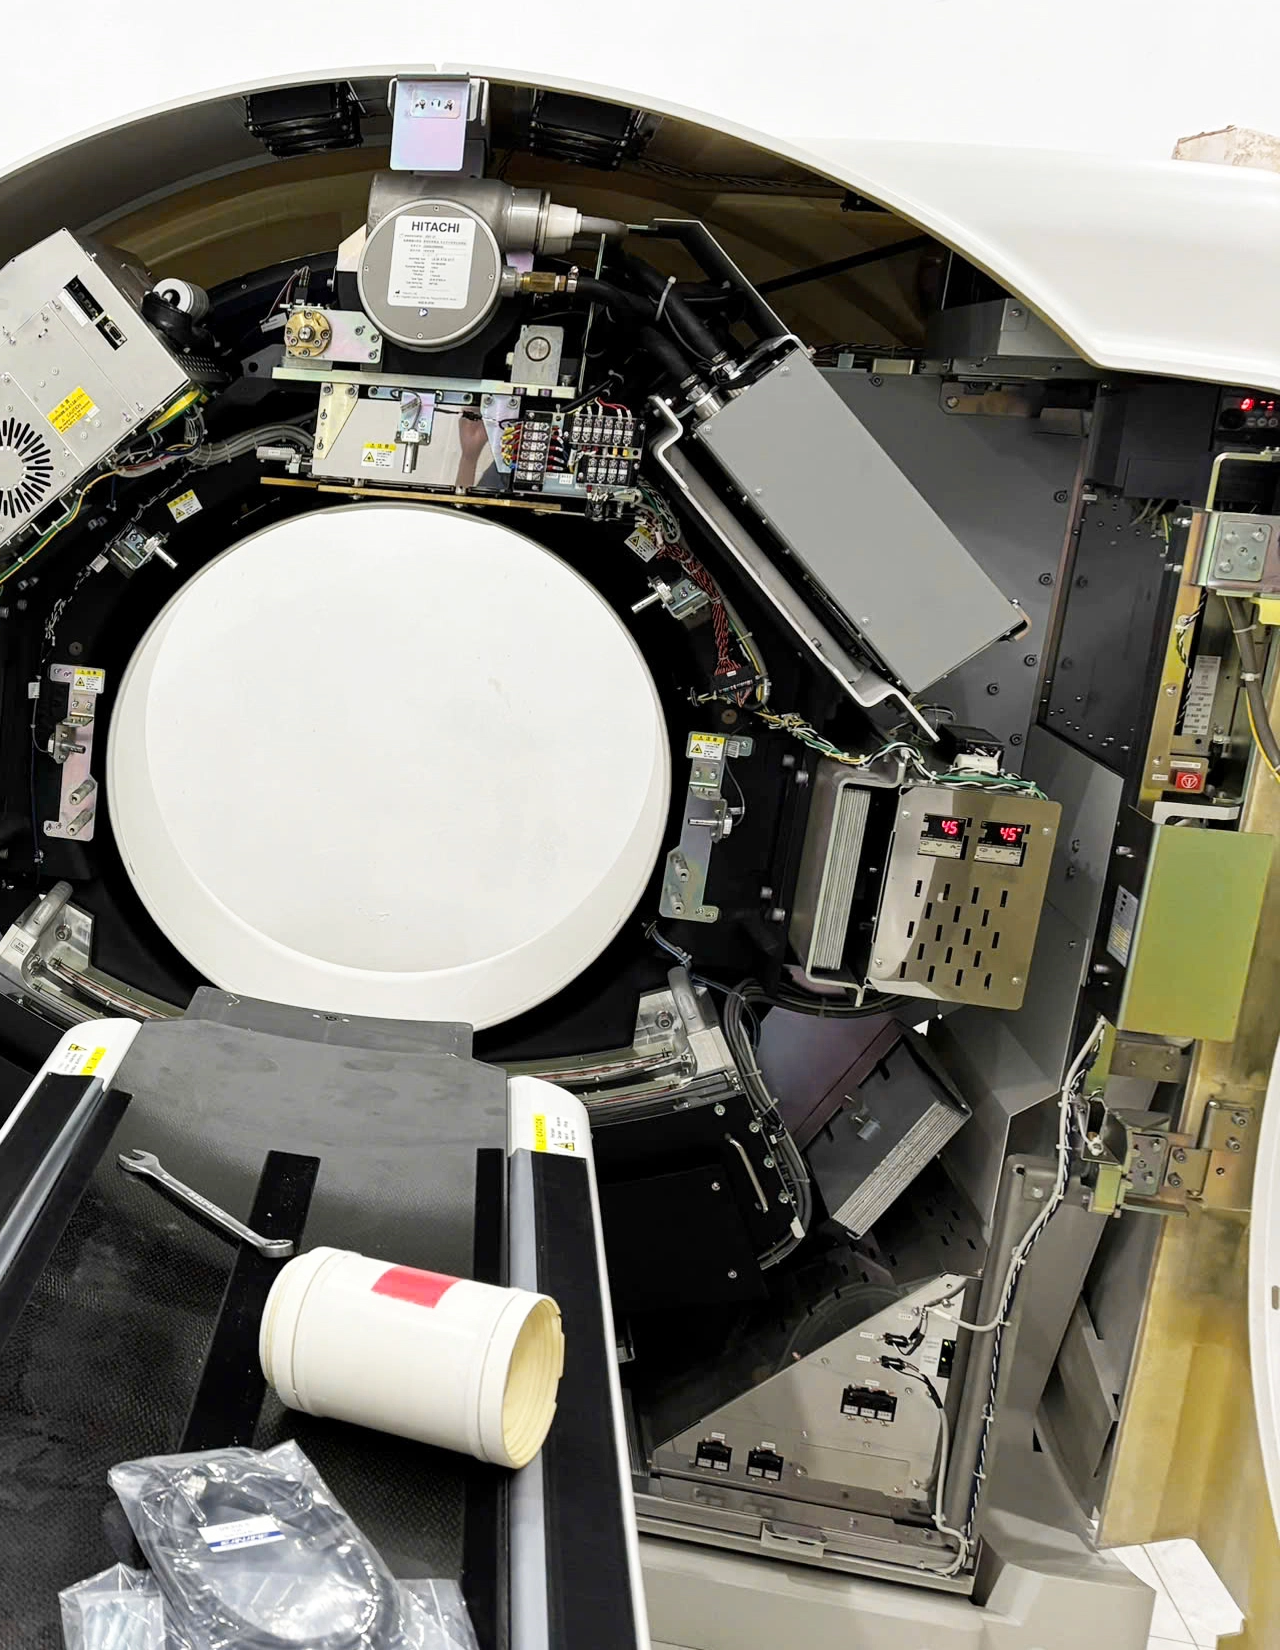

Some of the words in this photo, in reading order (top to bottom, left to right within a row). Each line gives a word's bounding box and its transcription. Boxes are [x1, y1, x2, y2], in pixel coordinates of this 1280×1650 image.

[411, 220, 460, 234] HITACHI
[941, 820, 959, 835] 45
[1000, 827, 1017, 841] 45
